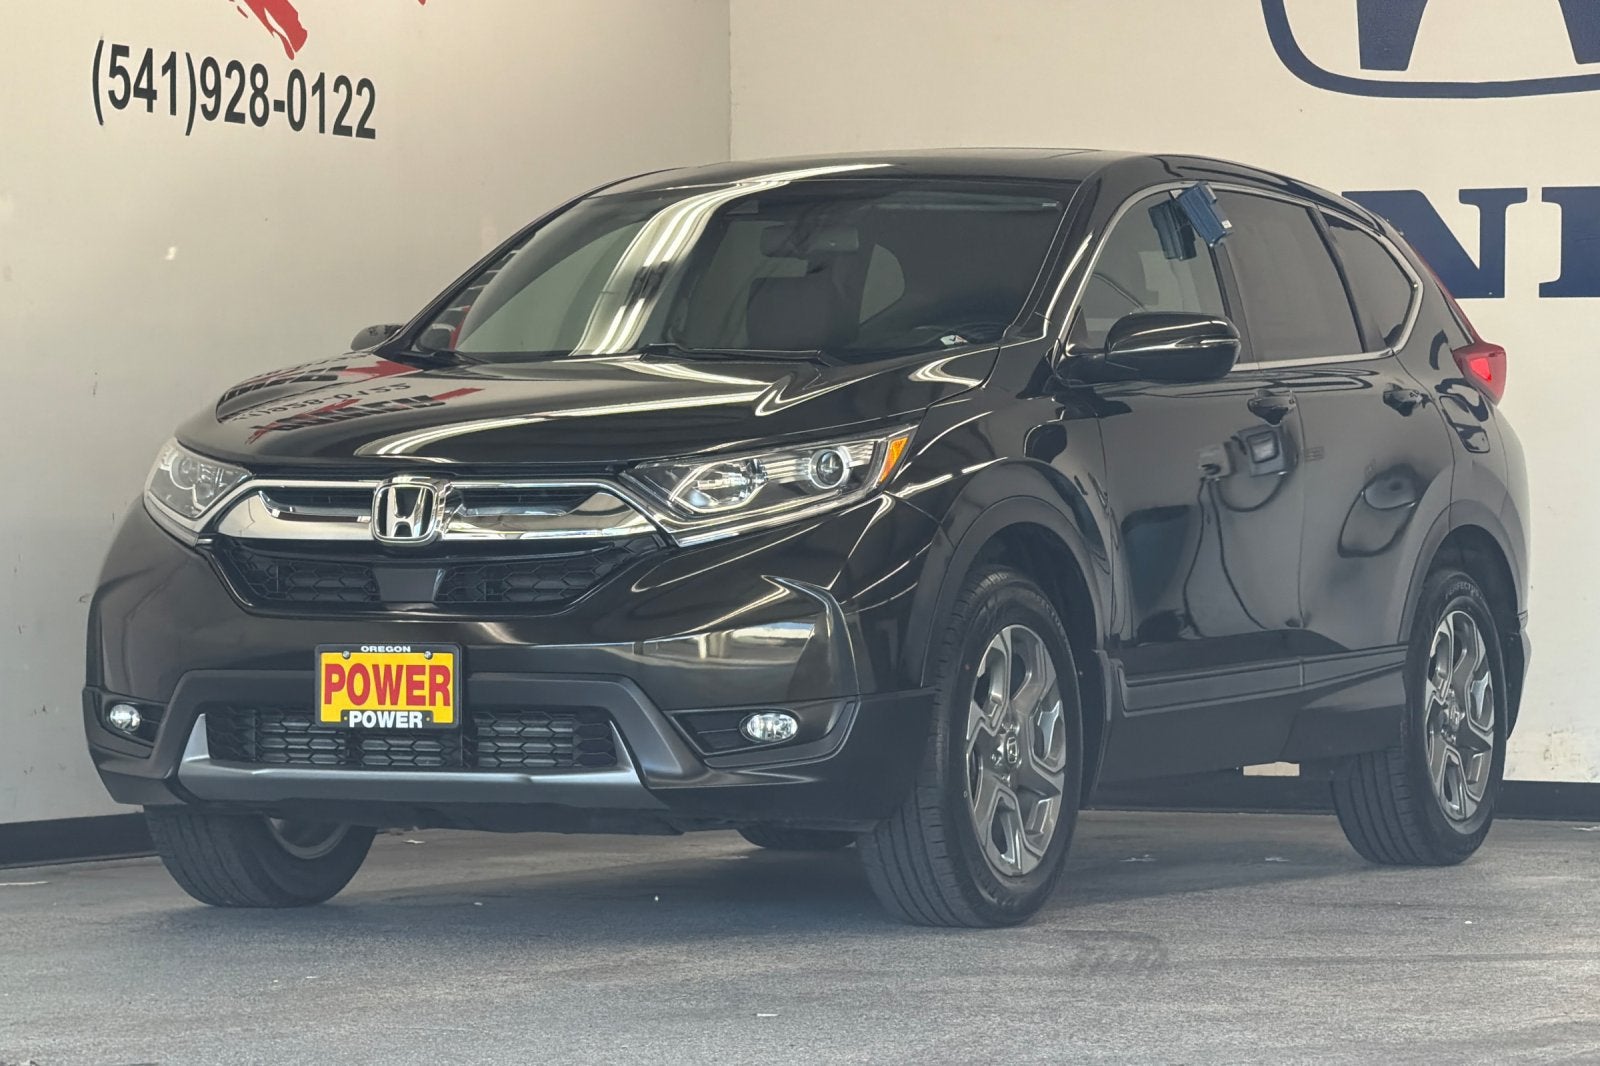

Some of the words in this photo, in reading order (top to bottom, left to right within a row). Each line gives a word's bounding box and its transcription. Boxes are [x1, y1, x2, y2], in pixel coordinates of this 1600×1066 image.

[92, 39, 376, 139] (541)928-0122
[360, 645, 411, 653] OREGON
[324, 662, 451, 707] POWER
[349, 711, 423, 729] POWER
